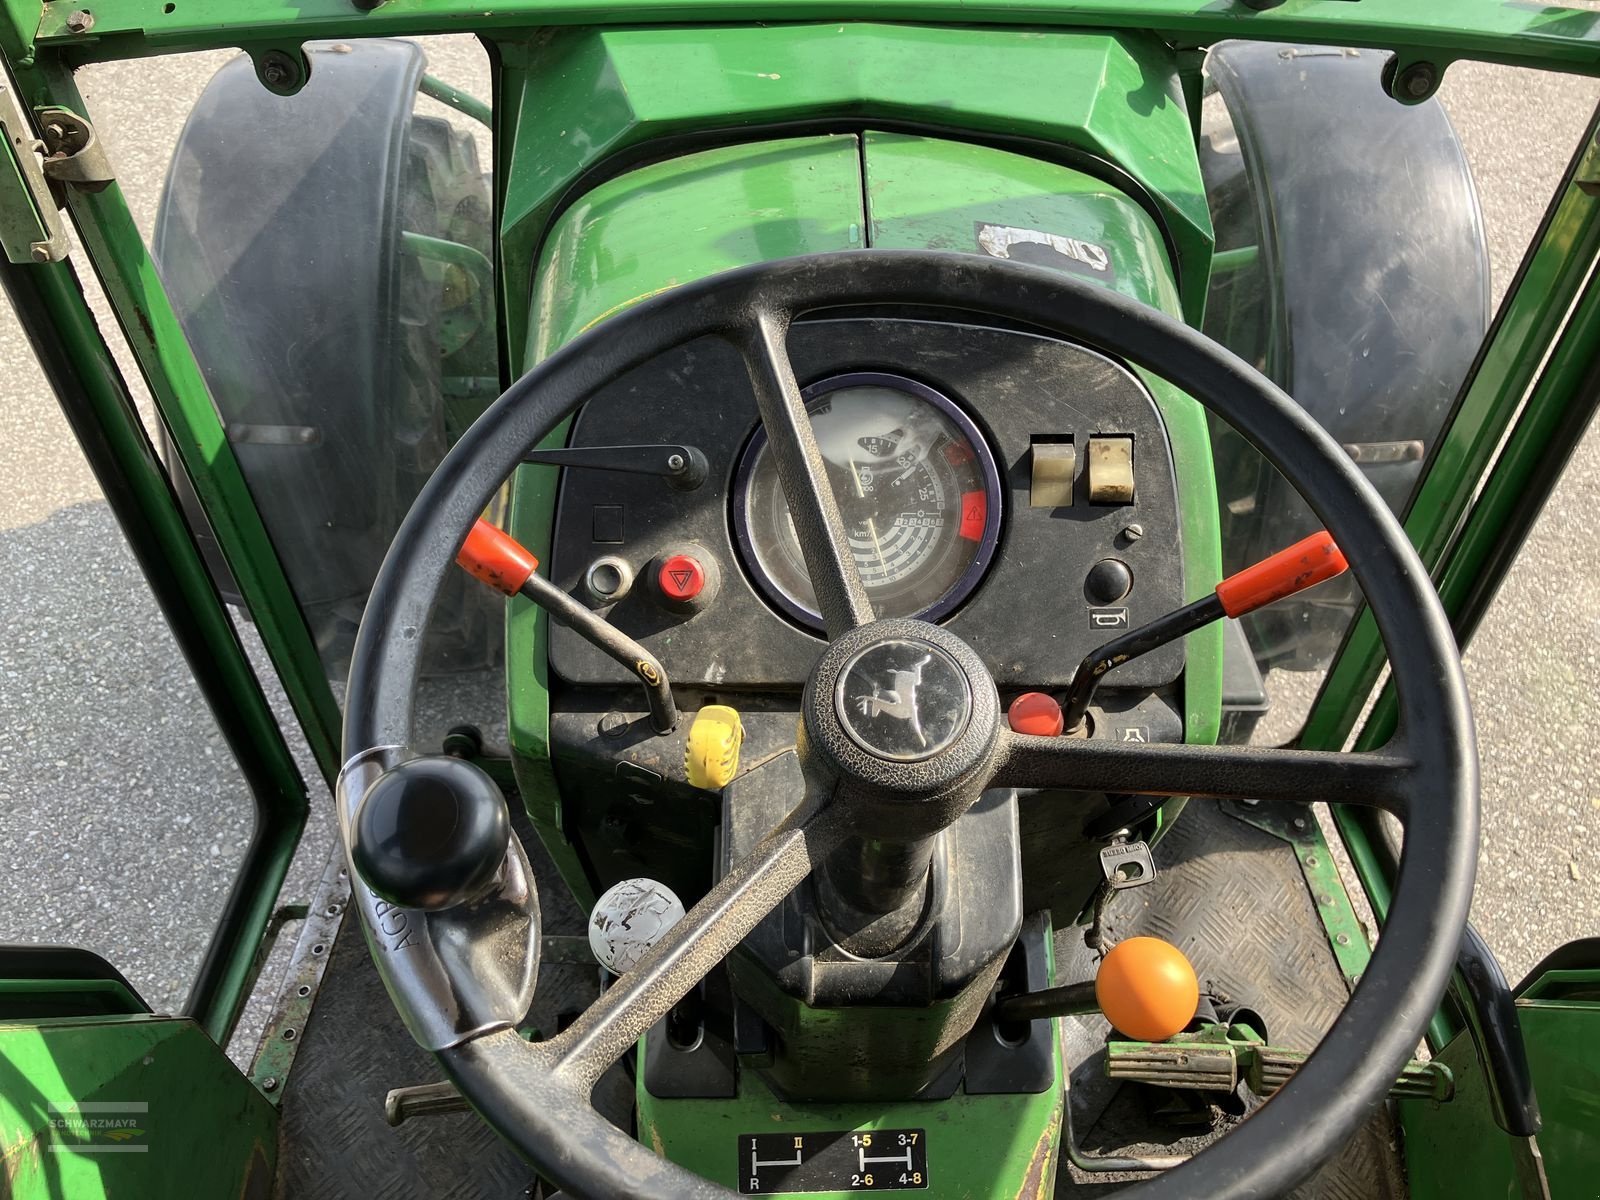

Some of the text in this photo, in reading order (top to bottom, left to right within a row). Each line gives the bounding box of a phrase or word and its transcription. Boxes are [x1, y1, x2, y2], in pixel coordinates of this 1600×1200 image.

[867, 445, 878, 454] 15
[897, 456, 911, 469] 20
[918, 487, 929, 501] 25
[854, 530, 873, 538] km/
[851, 1133, 919, 1147] 1-5 3-7
[750, 1178, 760, 1190] R
[851, 1172, 922, 1186] 2-6 4-8
